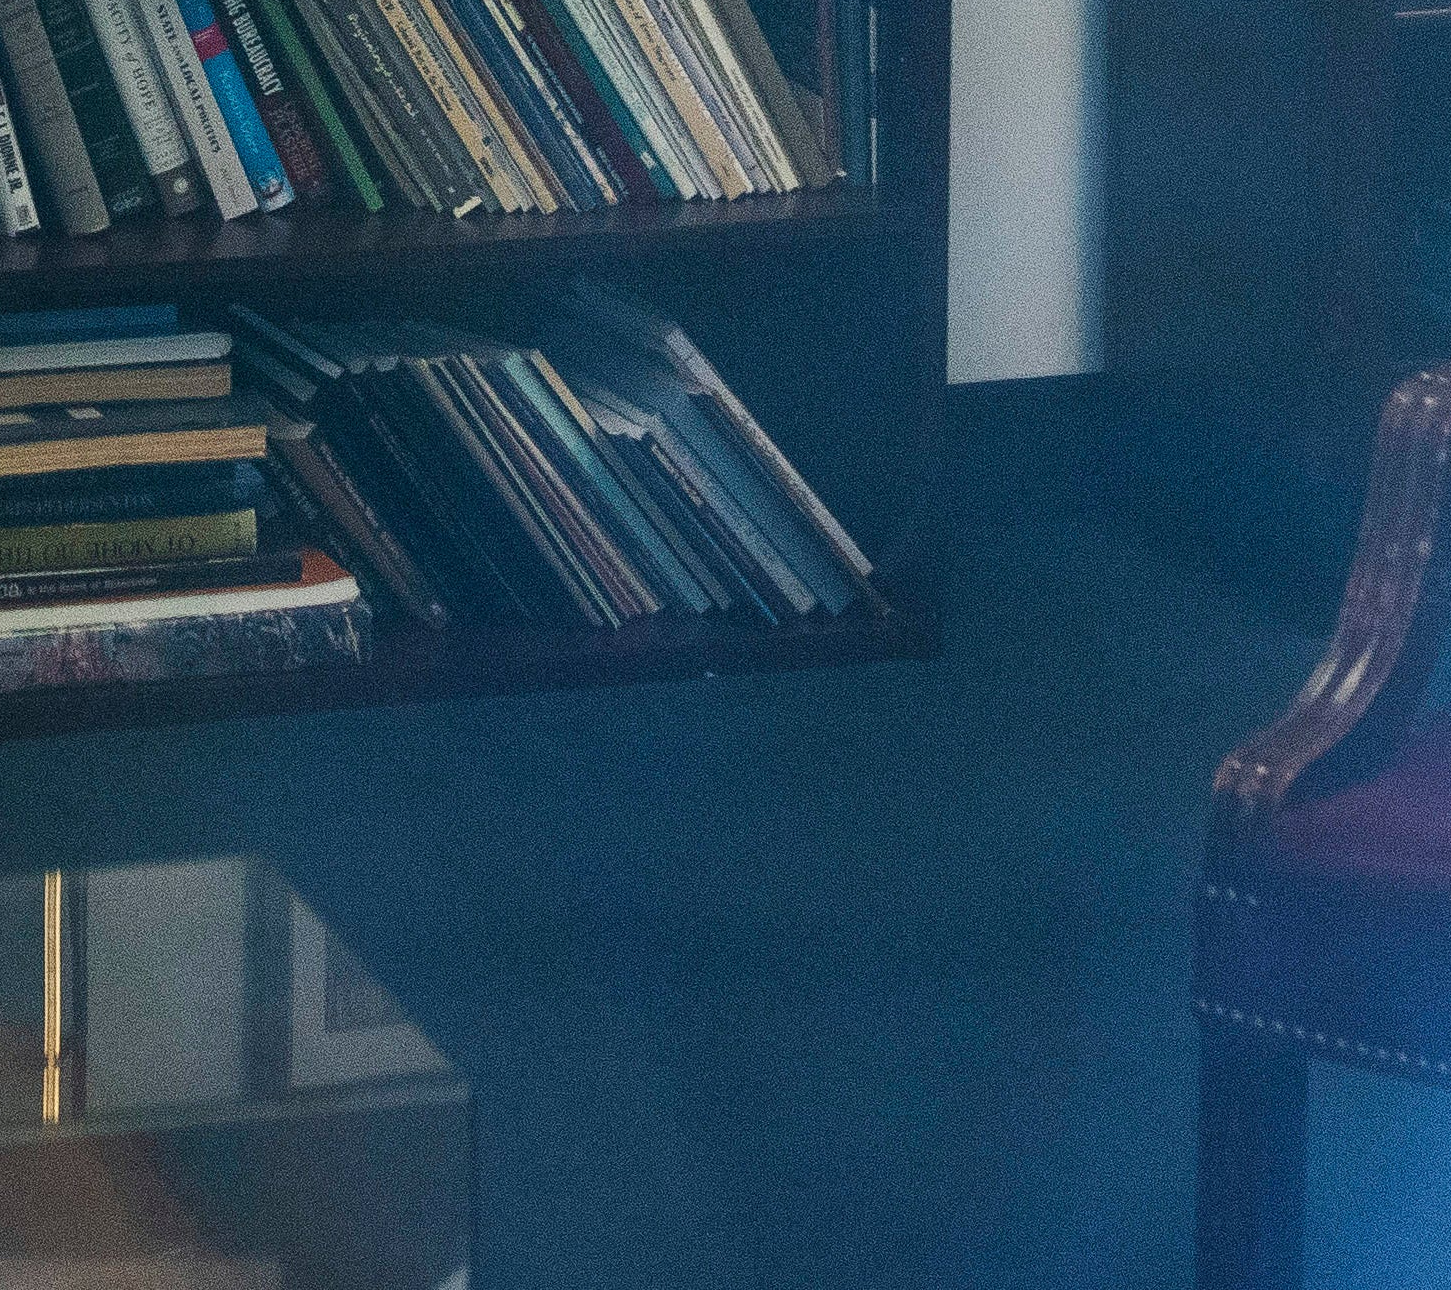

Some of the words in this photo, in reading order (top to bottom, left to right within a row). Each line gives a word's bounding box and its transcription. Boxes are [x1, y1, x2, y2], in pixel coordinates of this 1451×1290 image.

[120, 48, 141, 67] of
[228, 11, 285, 98] BUREAUCRACY
[130, 65, 158, 112] HOPE
[153, 2, 179, 43] STATE
[169, 43, 185, 64] AND
[177, 61, 204, 105] LOCAL
[193, 102, 223, 155] POLITICS
[6, 176, 24, 195] JR.
